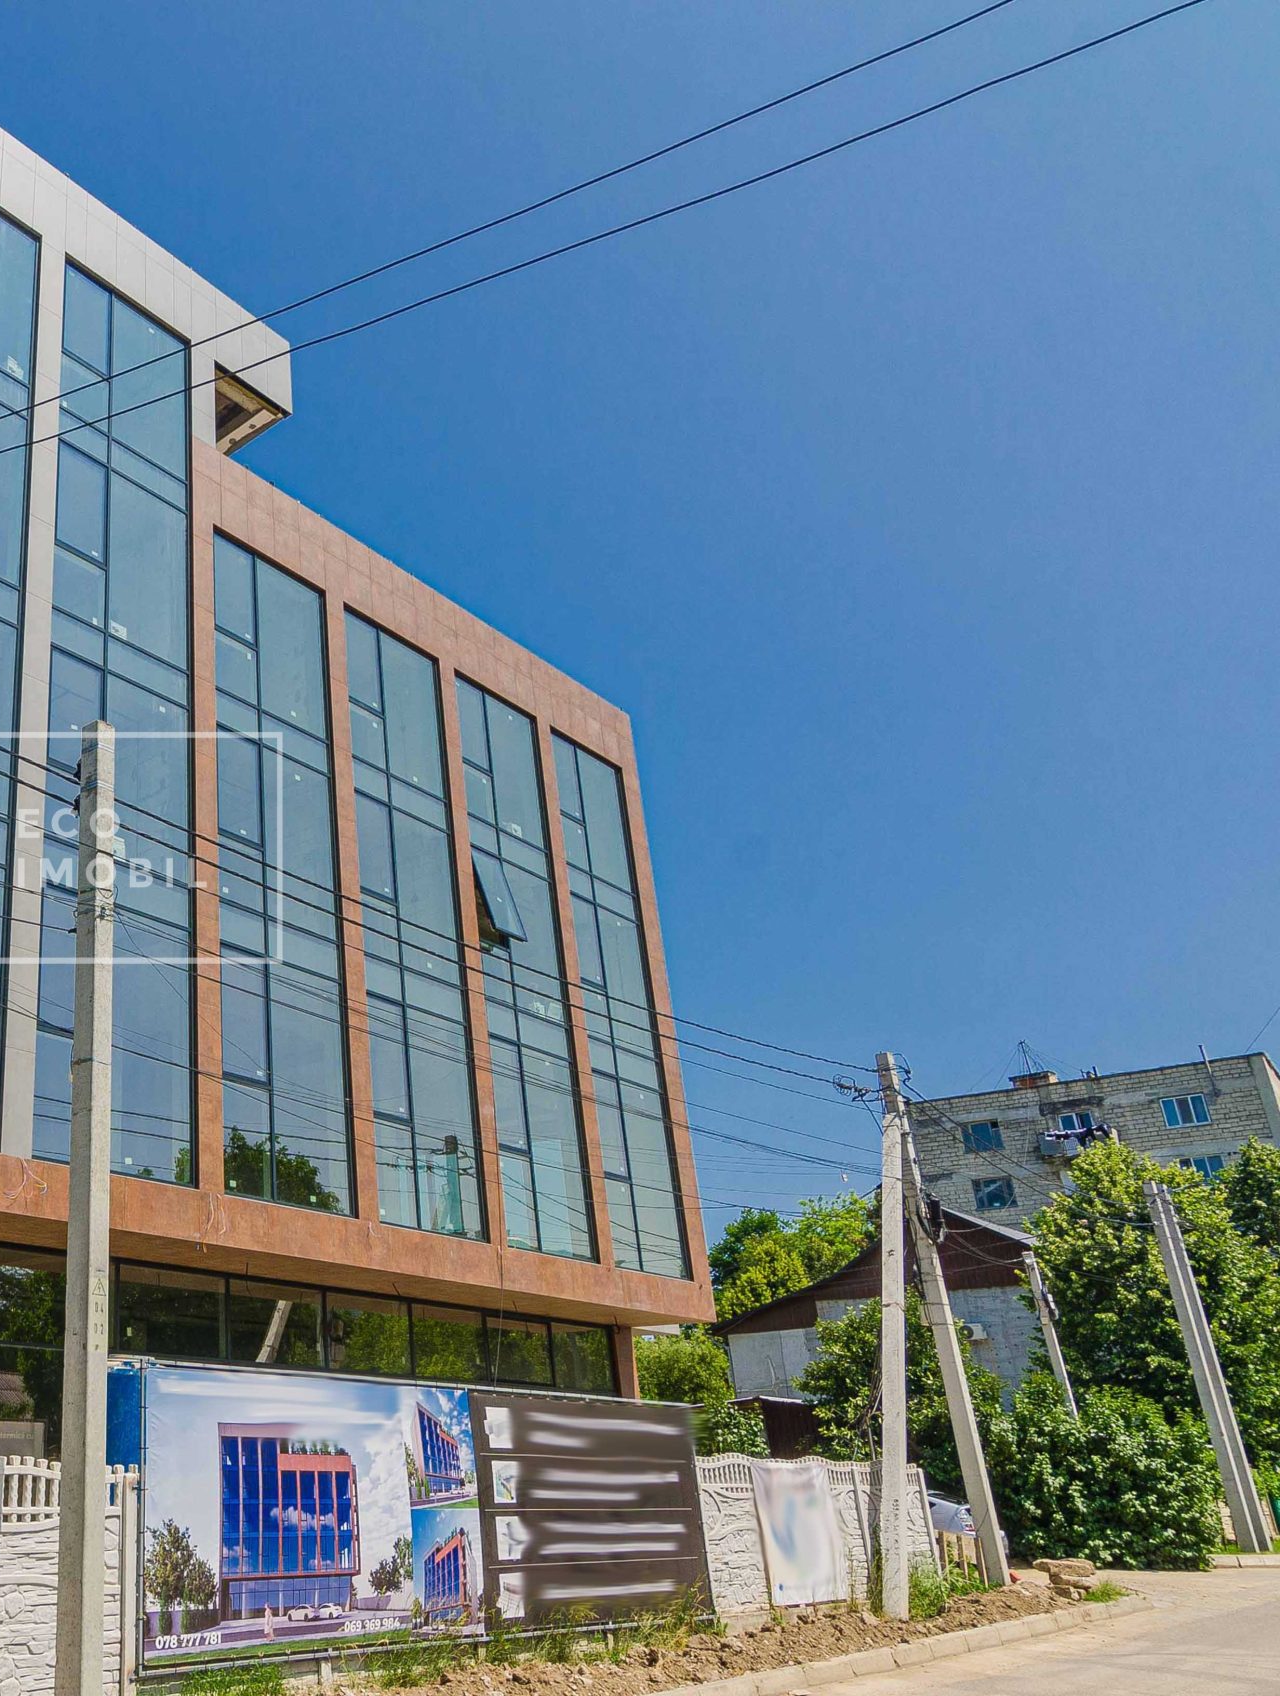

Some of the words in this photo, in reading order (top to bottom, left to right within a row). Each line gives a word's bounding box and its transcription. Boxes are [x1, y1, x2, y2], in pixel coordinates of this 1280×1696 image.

[344, 1620, 362, 1633] 069
[363, 1618, 381, 1632] 969
[155, 1634, 178, 1650] 078
[180, 1632, 202, 1647] 777
[203, 1631, 222, 1645] 781
